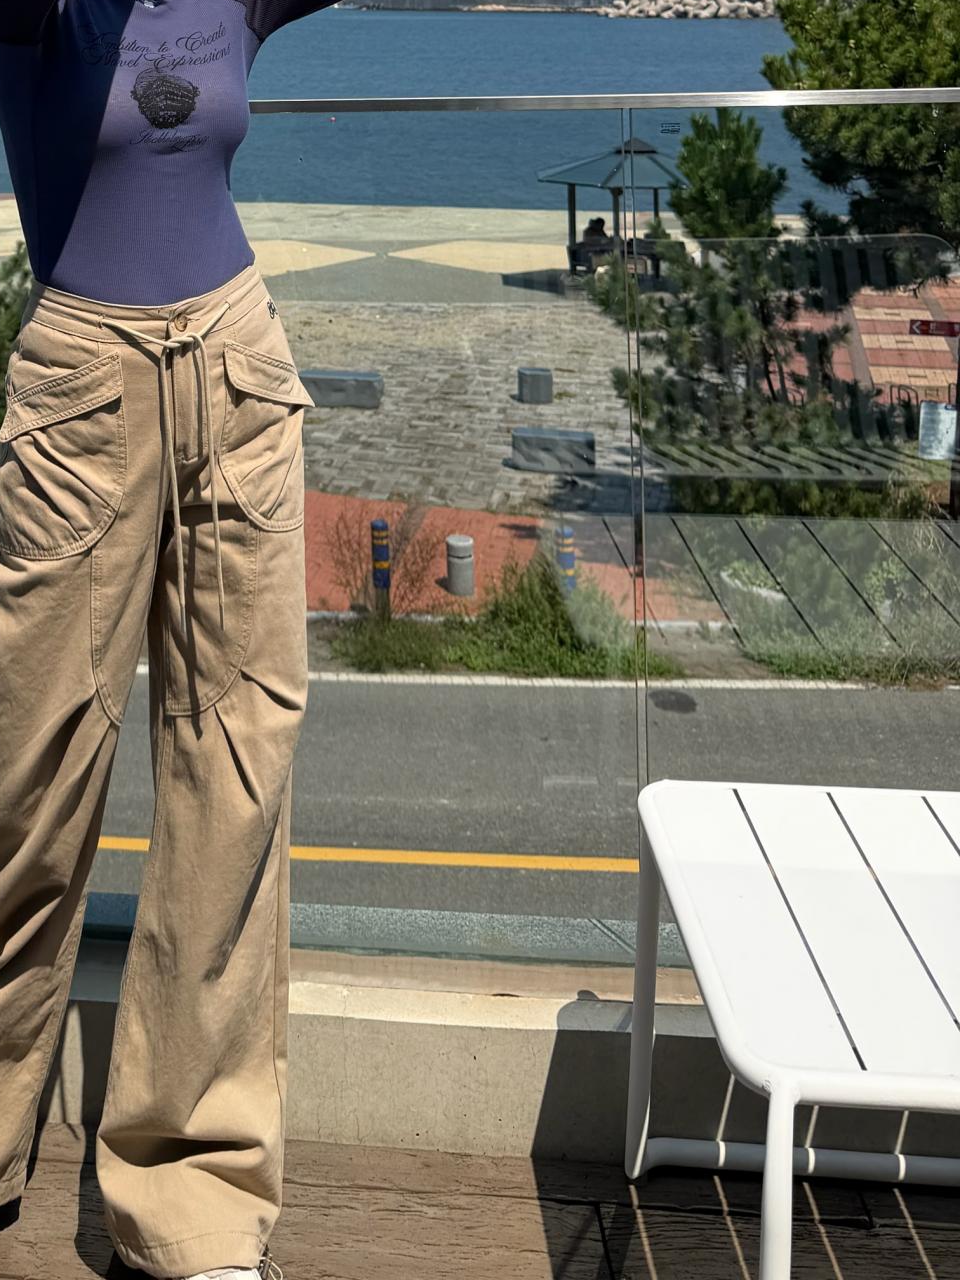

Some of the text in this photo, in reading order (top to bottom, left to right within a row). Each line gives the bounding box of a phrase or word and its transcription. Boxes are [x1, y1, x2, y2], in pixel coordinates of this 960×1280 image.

[158, 41, 169, 53] to
[176, 21, 226, 54] Create
[143, 43, 231, 72] Expressions
